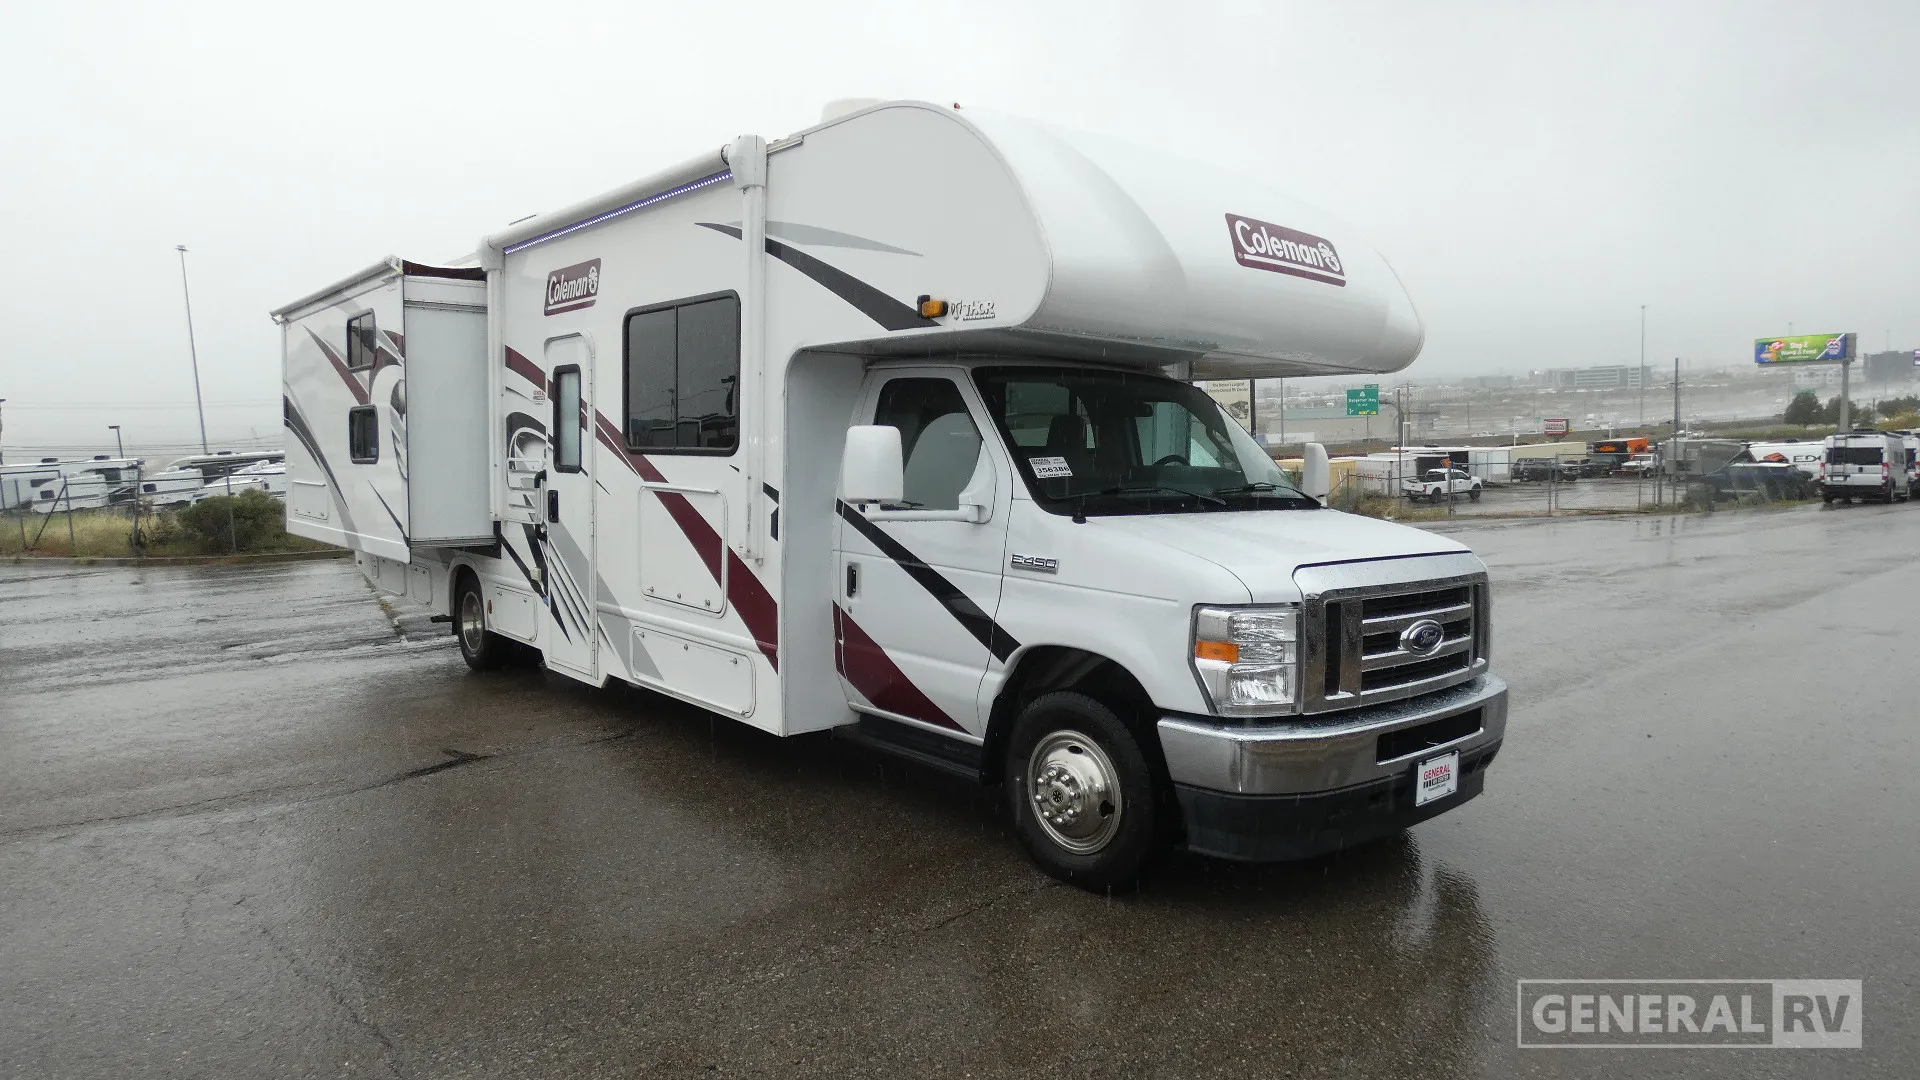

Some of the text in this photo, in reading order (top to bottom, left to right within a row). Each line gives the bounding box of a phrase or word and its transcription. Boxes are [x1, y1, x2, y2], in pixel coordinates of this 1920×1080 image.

[1235, 219, 1324, 268] Coleman
[548, 274, 588, 305] Coleman
[962, 300, 995, 317] THOR
[1423, 764, 1451, 780] GENERAL
